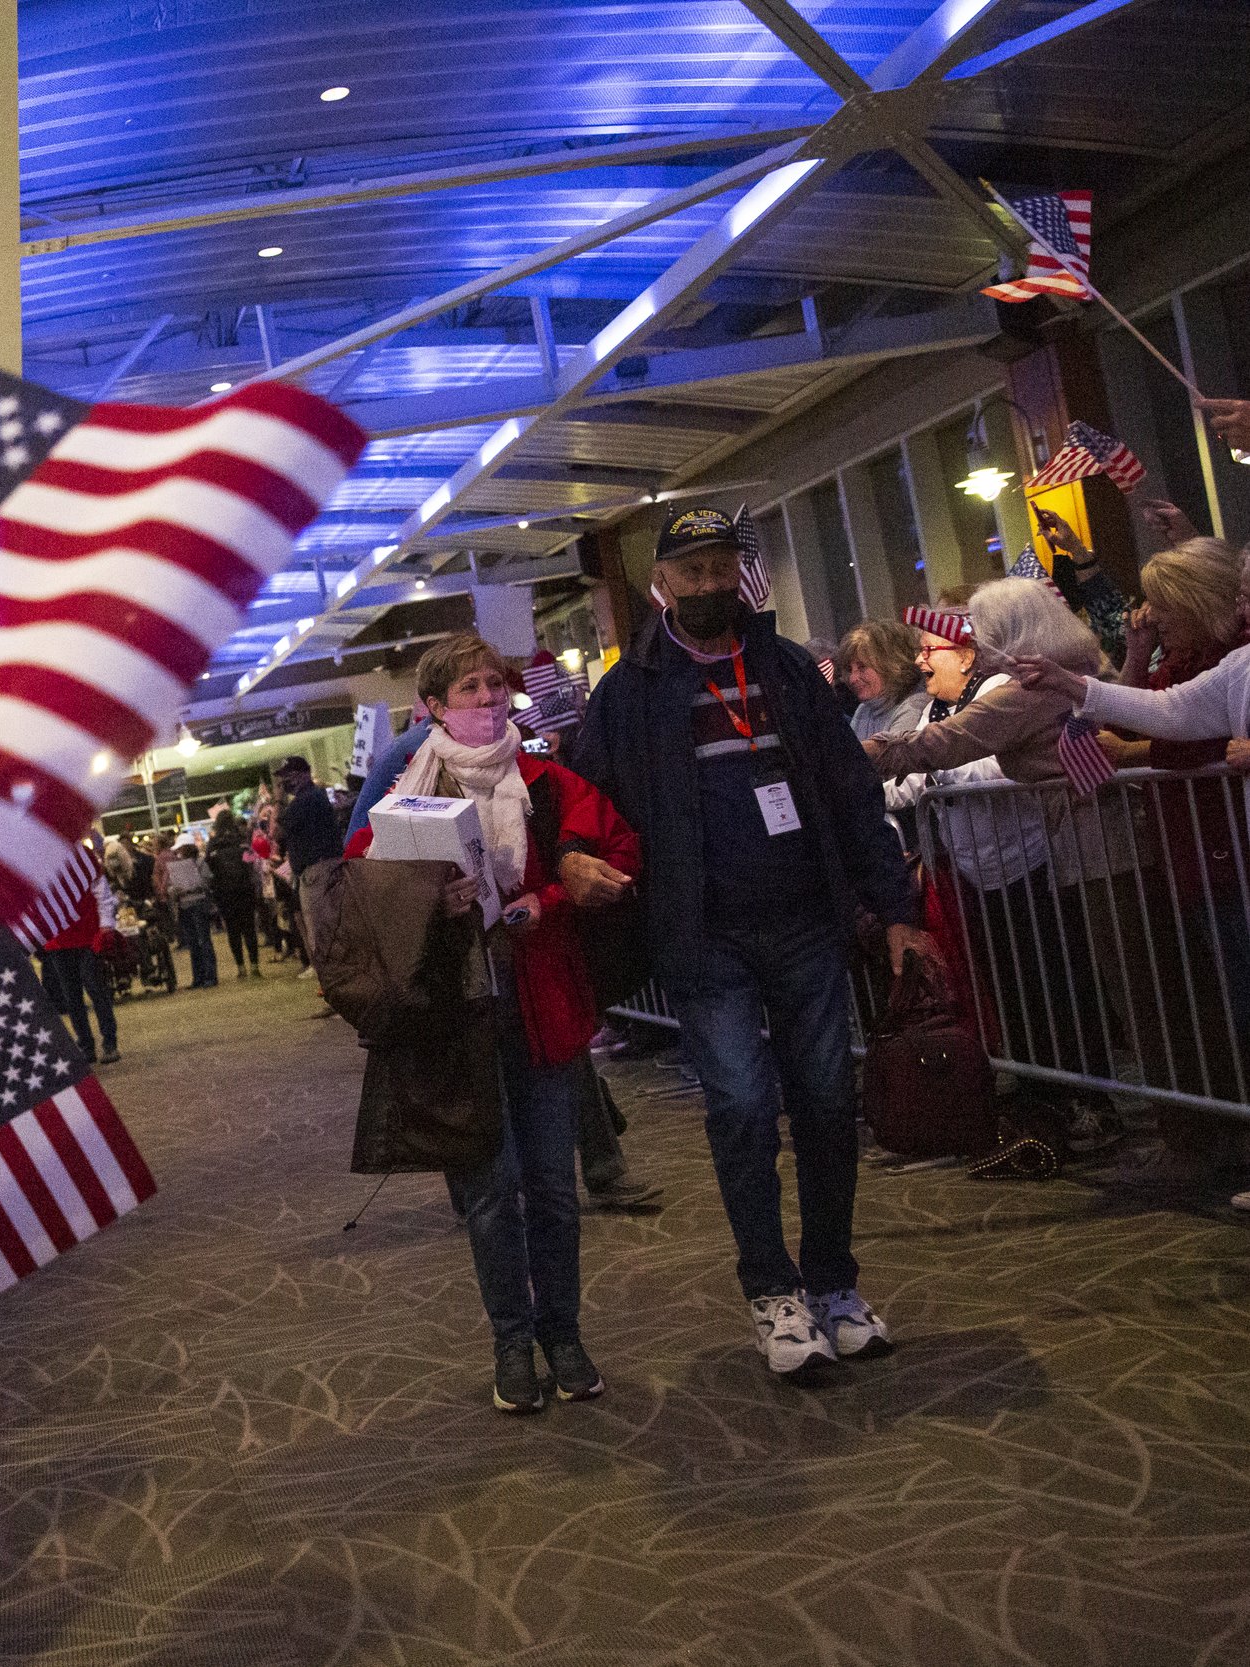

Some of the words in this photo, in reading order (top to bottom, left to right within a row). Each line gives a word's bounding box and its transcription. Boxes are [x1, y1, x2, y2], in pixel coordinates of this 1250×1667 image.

[670, 511, 695, 535] COMBAT
[697, 509, 731, 527] VETERAN
[691, 527, 717, 537] KOREA
